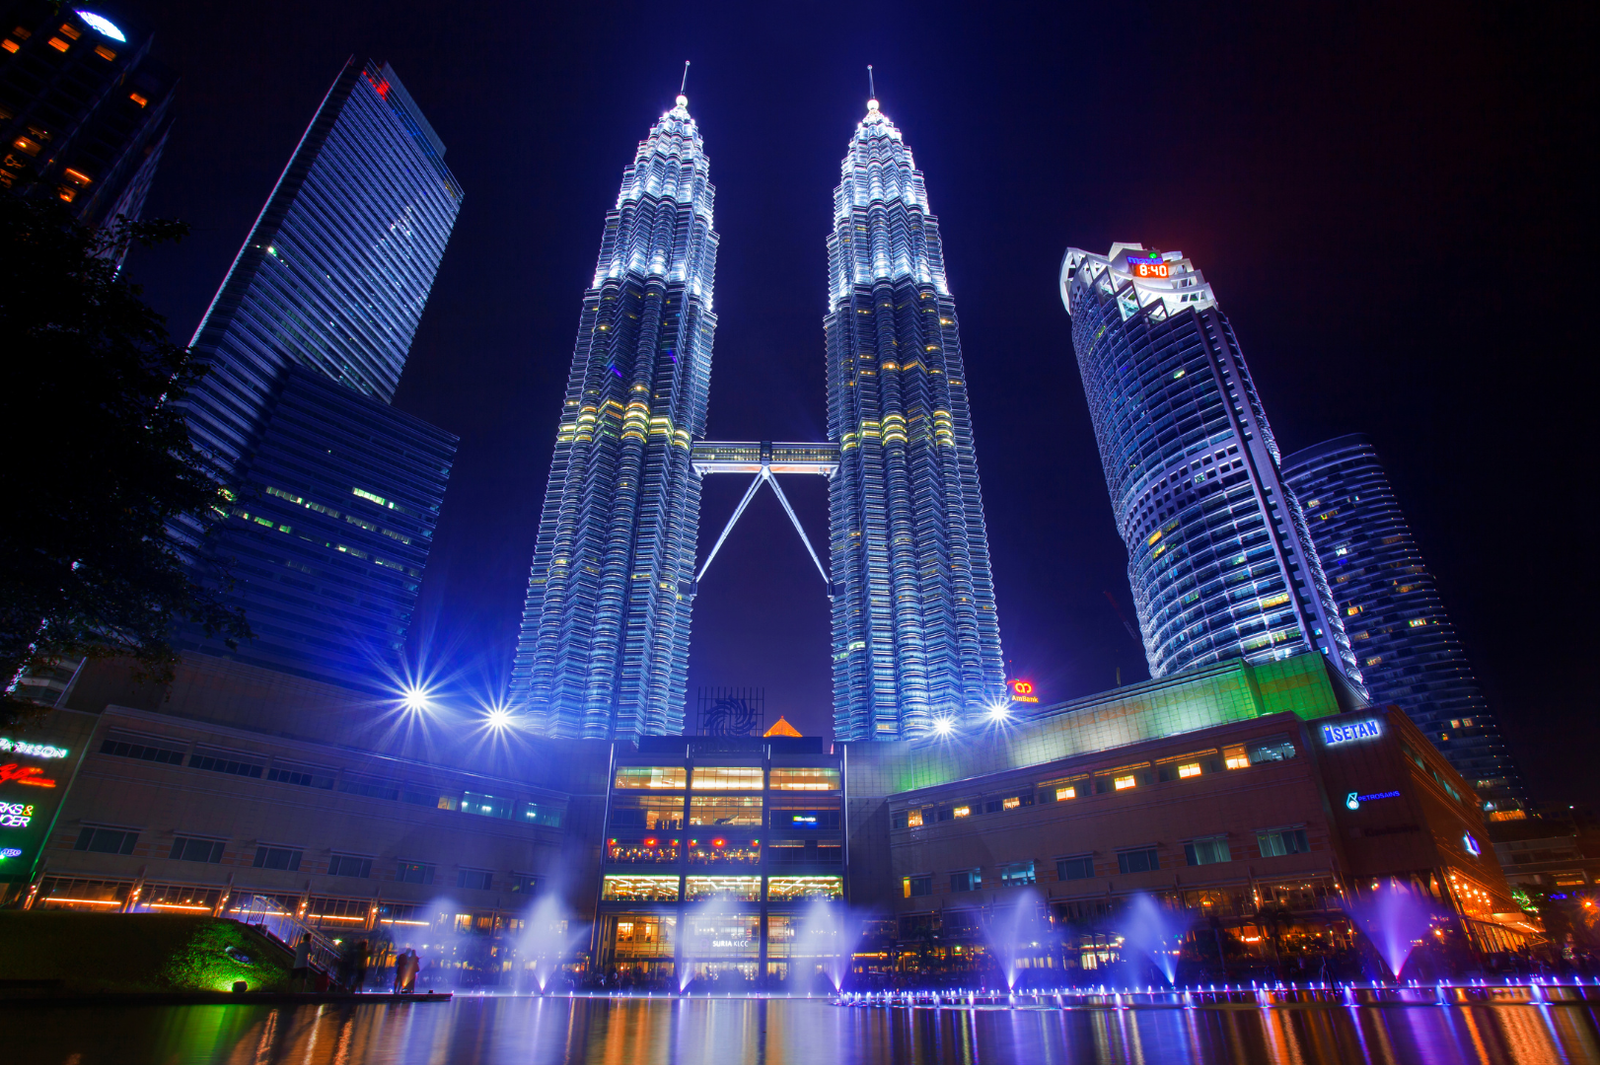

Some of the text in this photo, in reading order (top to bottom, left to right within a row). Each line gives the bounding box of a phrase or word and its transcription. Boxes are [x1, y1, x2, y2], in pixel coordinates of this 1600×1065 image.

[1139, 264, 1167, 276] 8:40
[1011, 695, 1039, 703] AmBank
[1357, 790, 1401, 802] PETROSAINS
[22, 804, 34, 816] &
